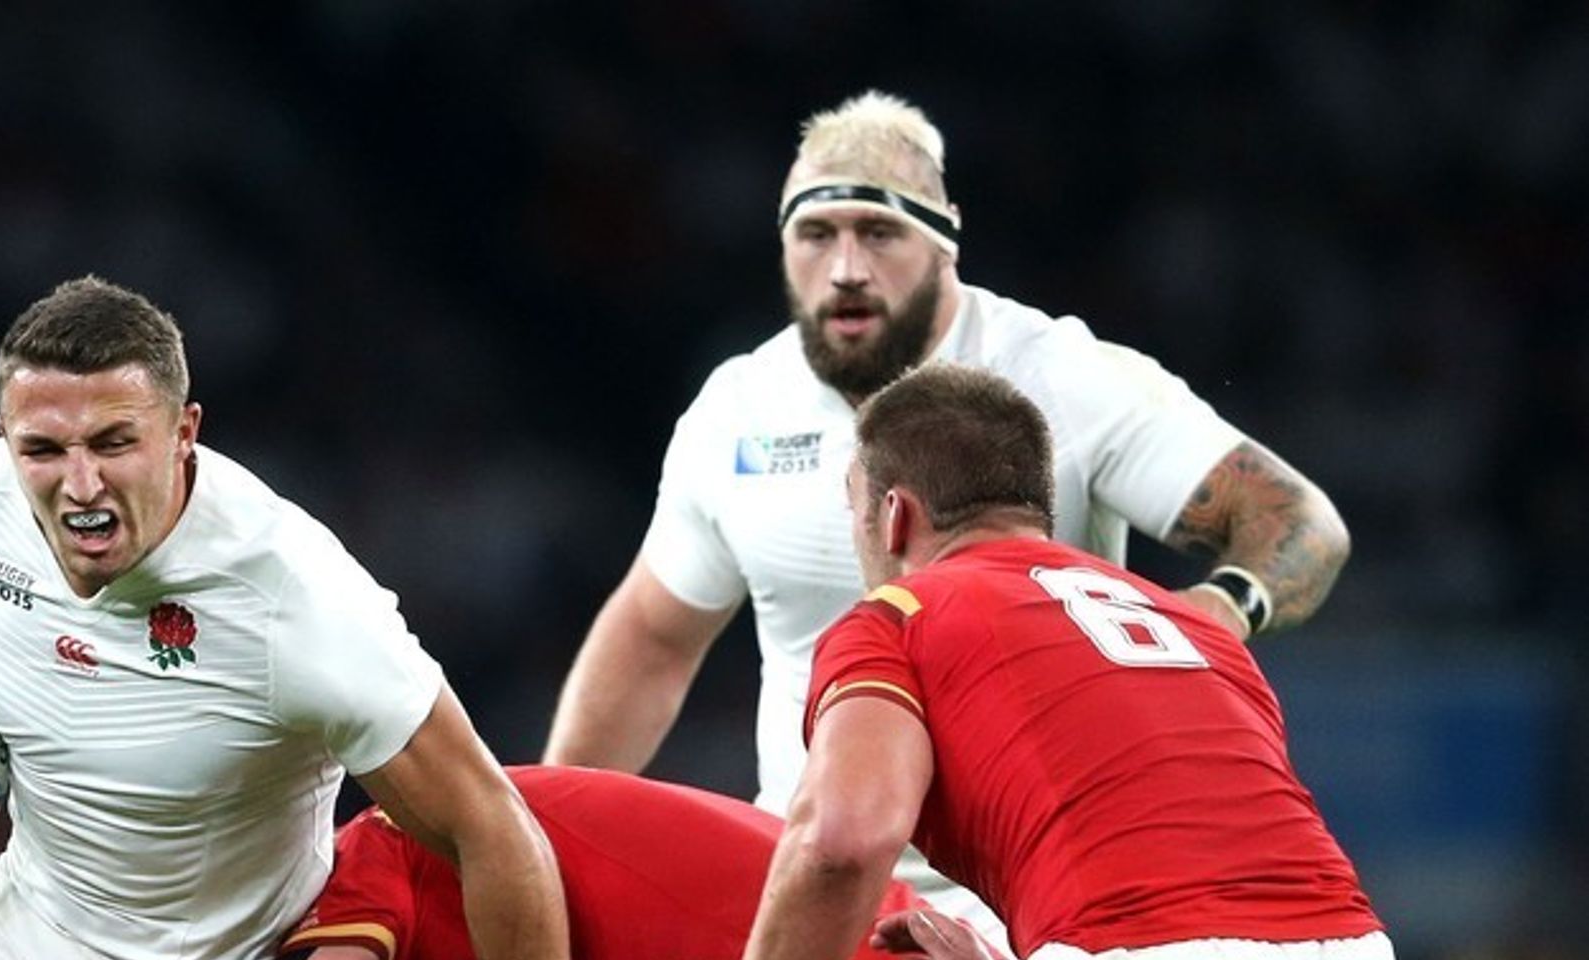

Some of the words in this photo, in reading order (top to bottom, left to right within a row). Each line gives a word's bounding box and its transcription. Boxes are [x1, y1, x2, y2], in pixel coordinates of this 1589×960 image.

[772, 432, 823, 449] RUGBY
[768, 458, 820, 474] 2015
[1029, 565, 1210, 670] 6
